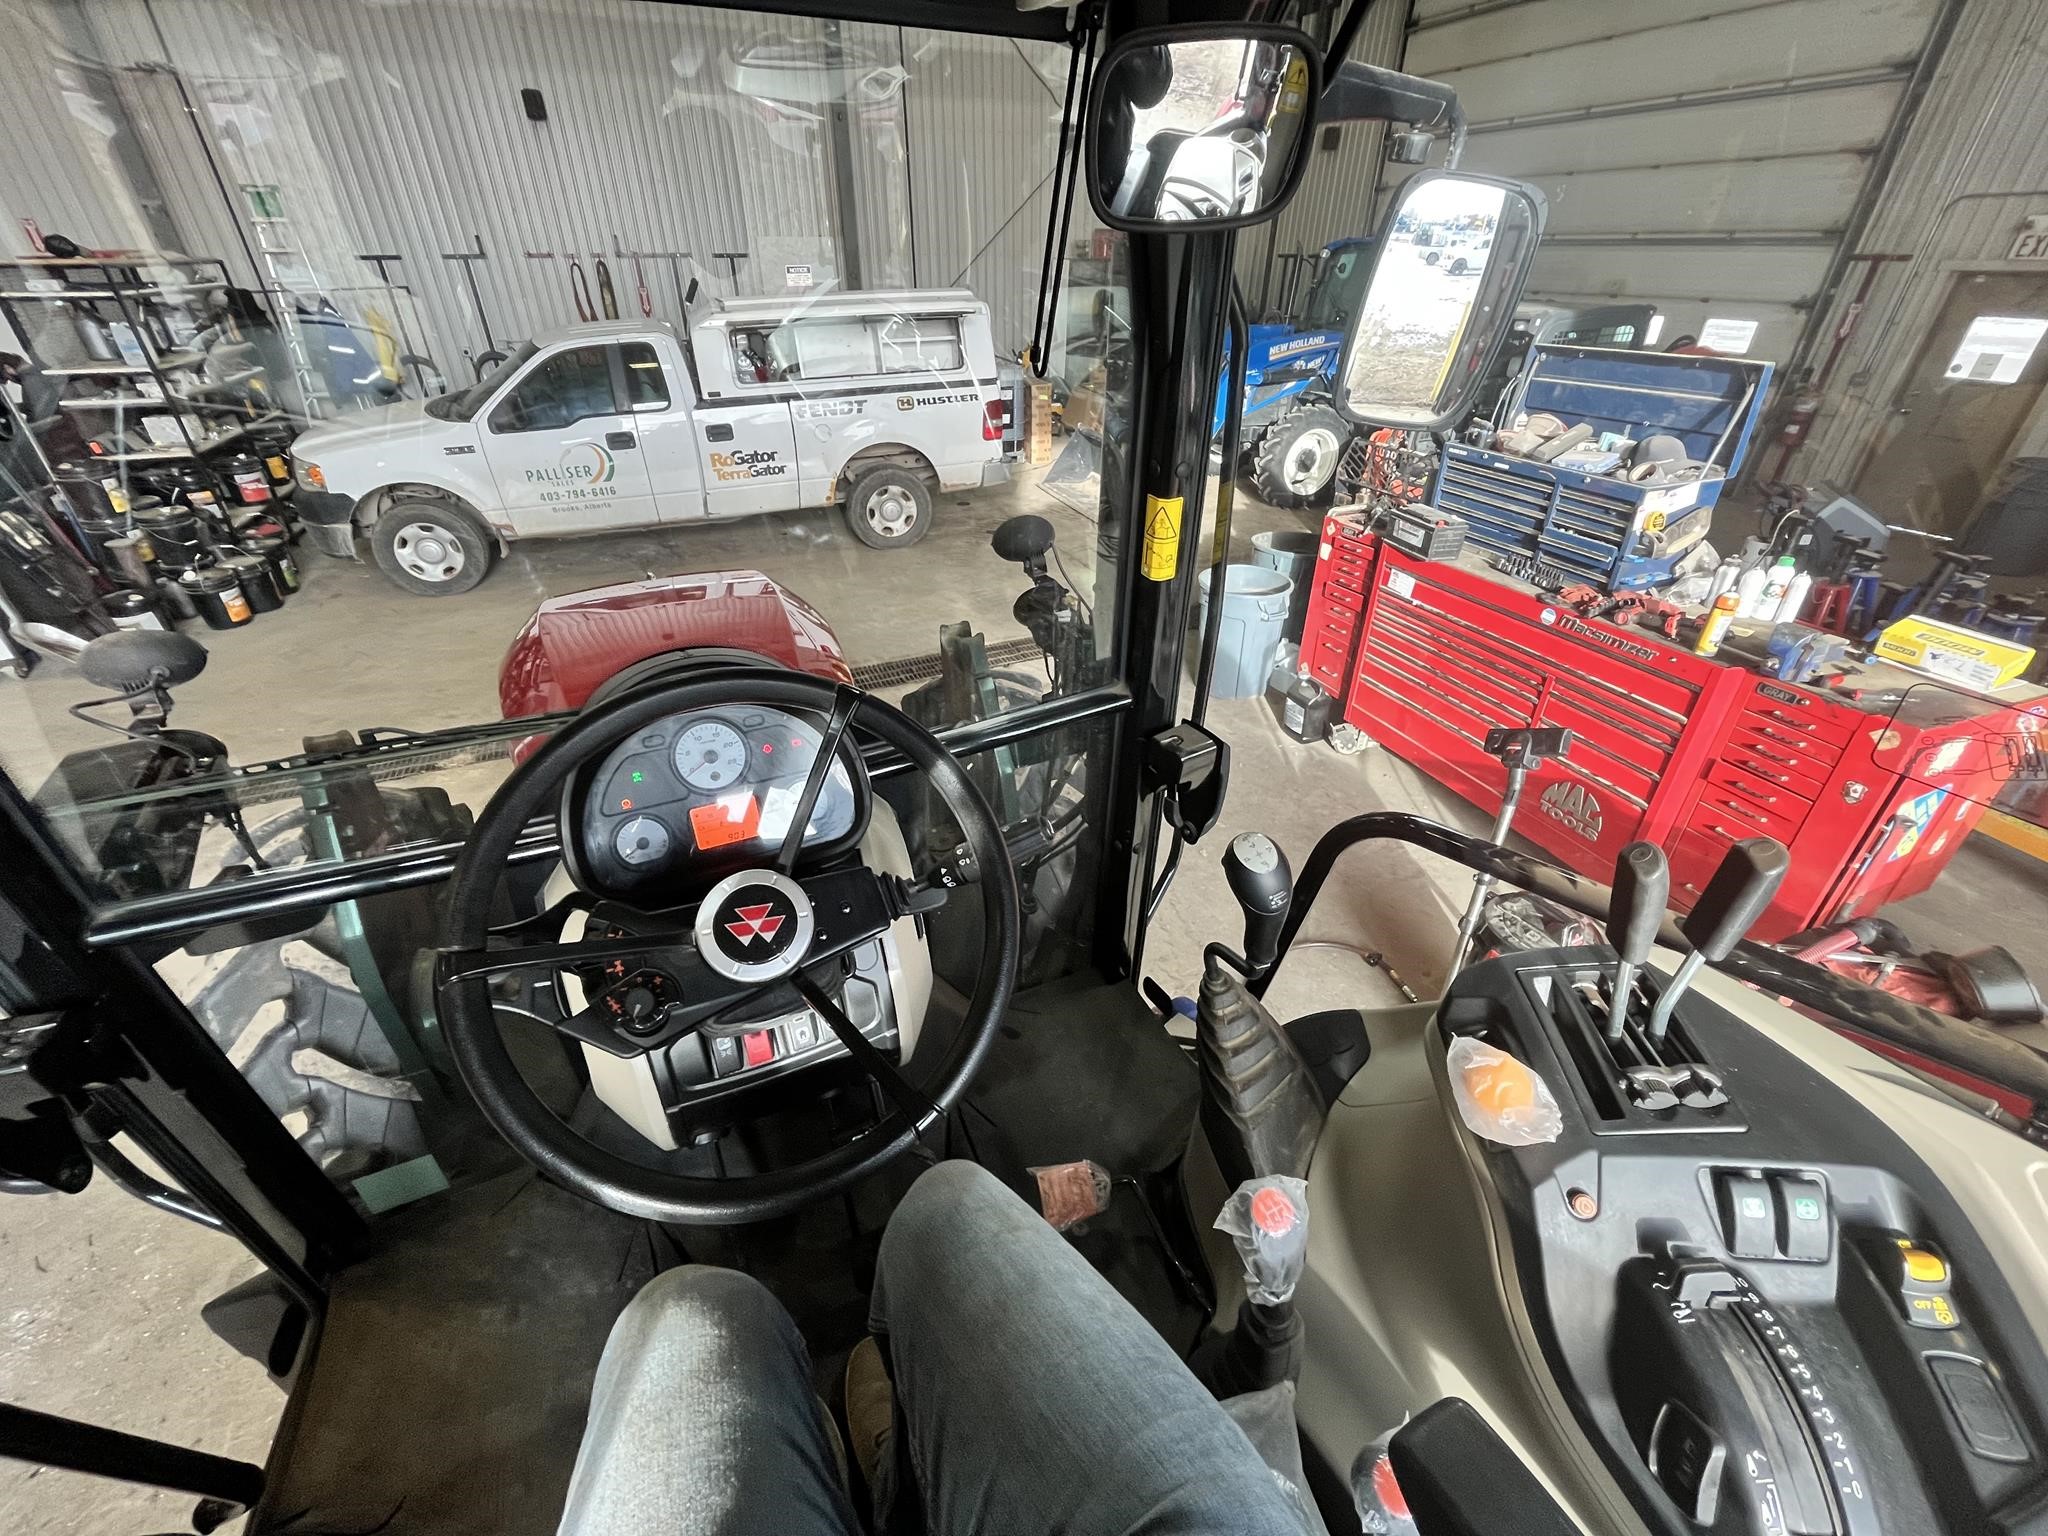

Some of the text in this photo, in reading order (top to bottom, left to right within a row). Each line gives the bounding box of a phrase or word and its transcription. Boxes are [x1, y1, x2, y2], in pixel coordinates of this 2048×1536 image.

[2015, 235, 2048, 258] EXI
[1269, 335, 1326, 355] NEW HOLLAND
[917, 393, 979, 407] HUSTLER
[794, 399, 868, 419] FENDT
[709, 450, 778, 468] RoGator
[525, 464, 593, 483] PALLISER
[713, 464, 787, 481] TerraGator
[540, 486, 617, 503] 403-794-6416
[1763, 686, 1791, 701] GRAY
[1541, 782, 1602, 832] MAC
[1540, 799, 1599, 842] TOOLS
[1735, 1277, 1748, 1288] 10
[1748, 1292, 1759, 1303] 9
[1762, 1309, 1774, 1322] 8
[1772, 1326, 1785, 1340] 7
[1786, 1344, 1798, 1359] 6
[1797, 1363, 1811, 1379] 5
[1812, 1385, 1823, 1401] 4
[1822, 1407, 1834, 1424] 3
[1833, 1432, 1846, 1449] 2
[1843, 1457, 1854, 1475] 1
[1851, 1480, 1863, 1499] 0
